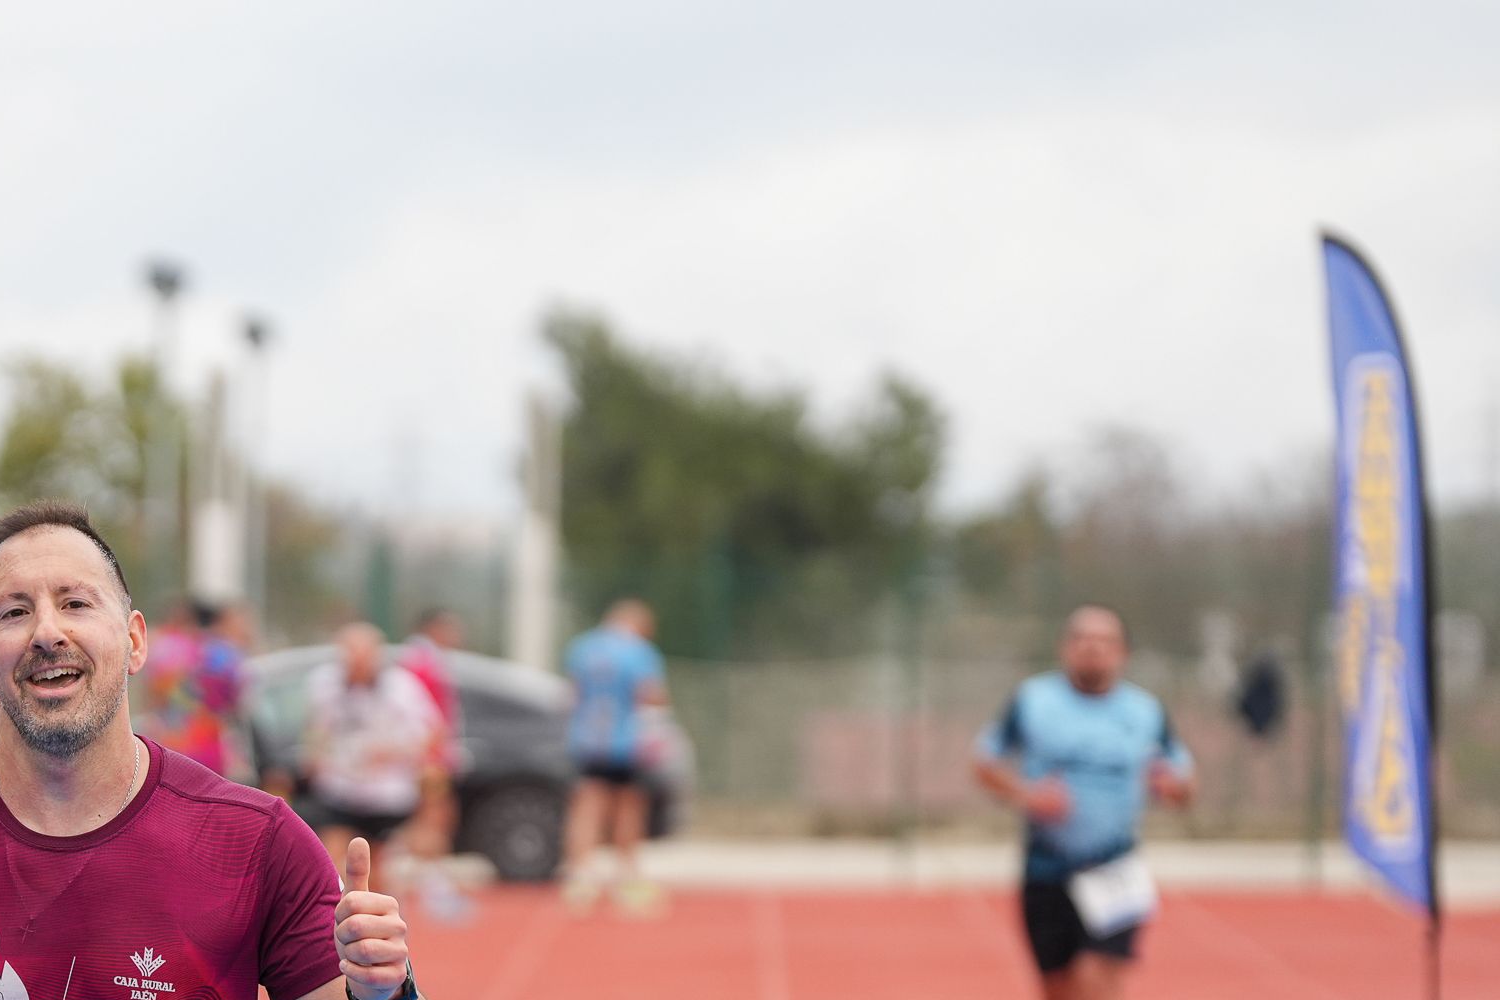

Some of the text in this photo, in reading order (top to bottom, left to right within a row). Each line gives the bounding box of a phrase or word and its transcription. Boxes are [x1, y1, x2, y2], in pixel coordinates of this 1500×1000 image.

[113, 976, 176, 992] CAJA RURAL
[130, 990, 157, 1000] JAÉN
